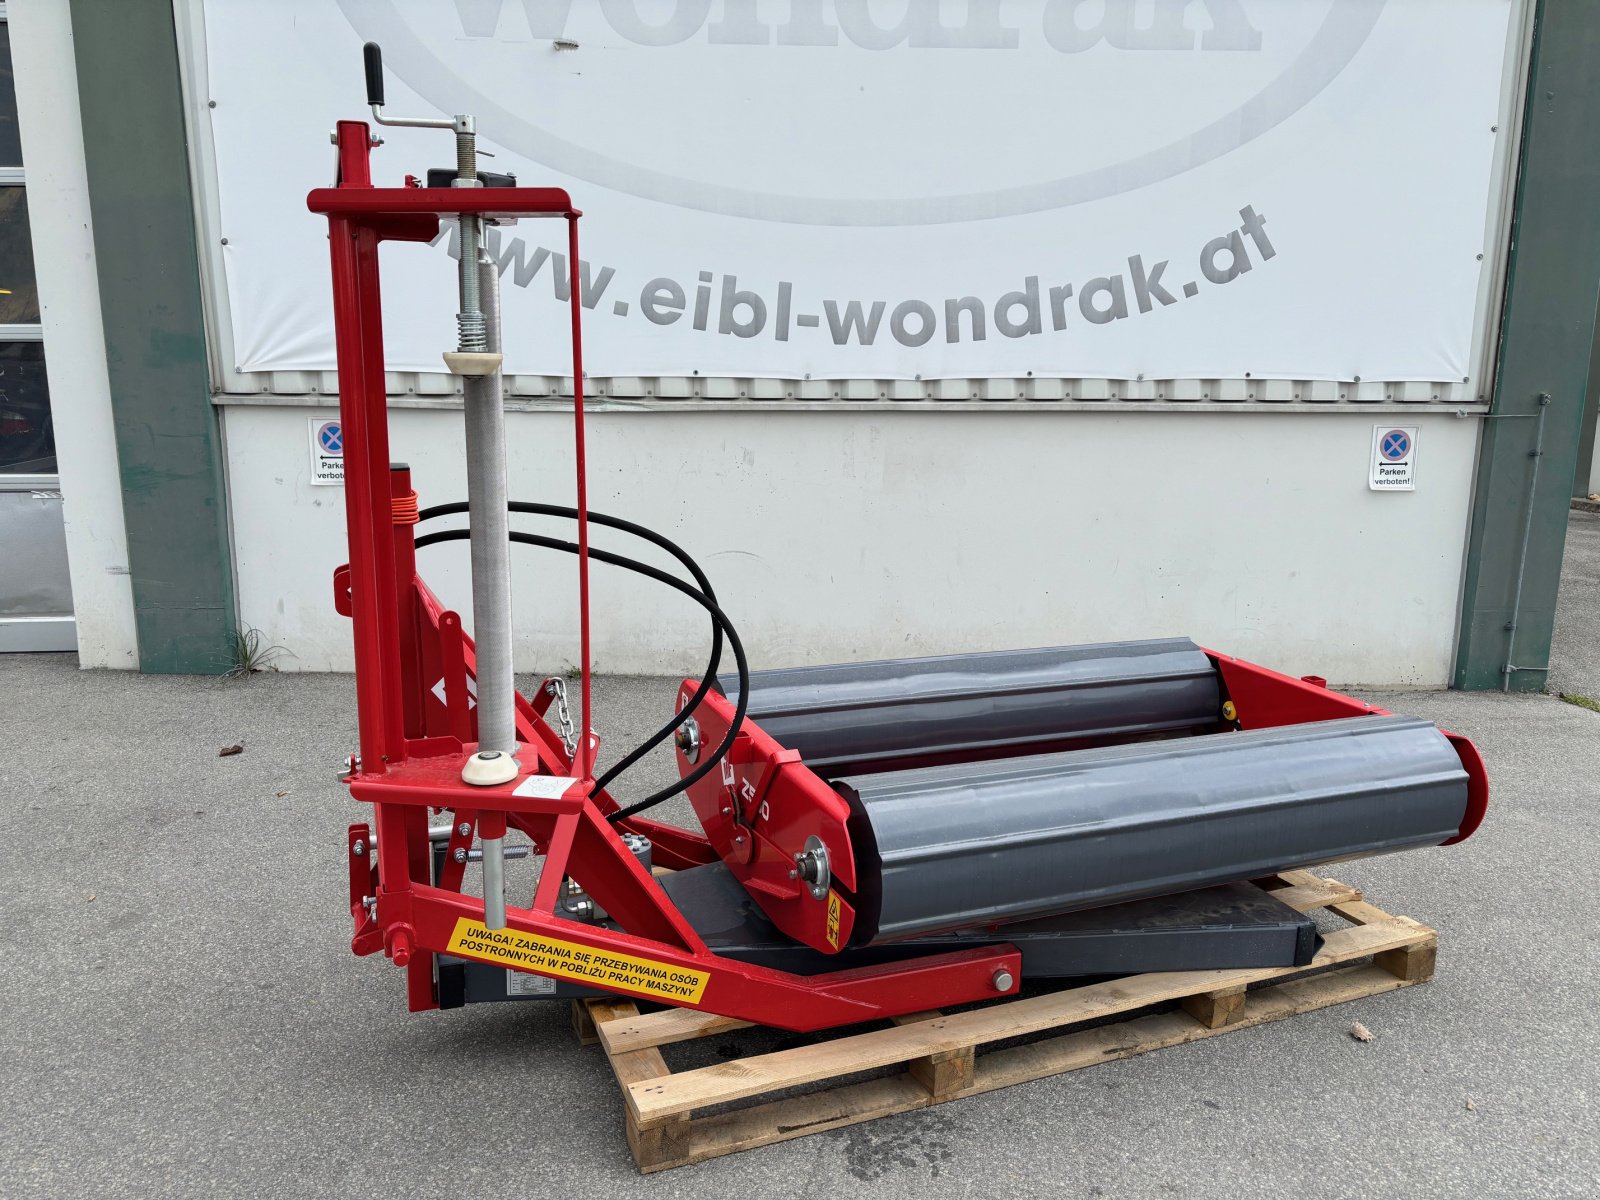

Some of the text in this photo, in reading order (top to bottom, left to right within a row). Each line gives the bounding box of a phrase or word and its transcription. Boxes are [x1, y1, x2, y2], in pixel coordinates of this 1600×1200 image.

[459, 938, 545, 967] POSTRONNYCH
[547, 957, 560, 968] W
[608, 971, 644, 987] PRACY
[645, 979, 695, 997] MASZYNY
[466, 927, 699, 987] UWAGA! ZABRANIA SIĘ PRZEBYWANIA OSÓB
